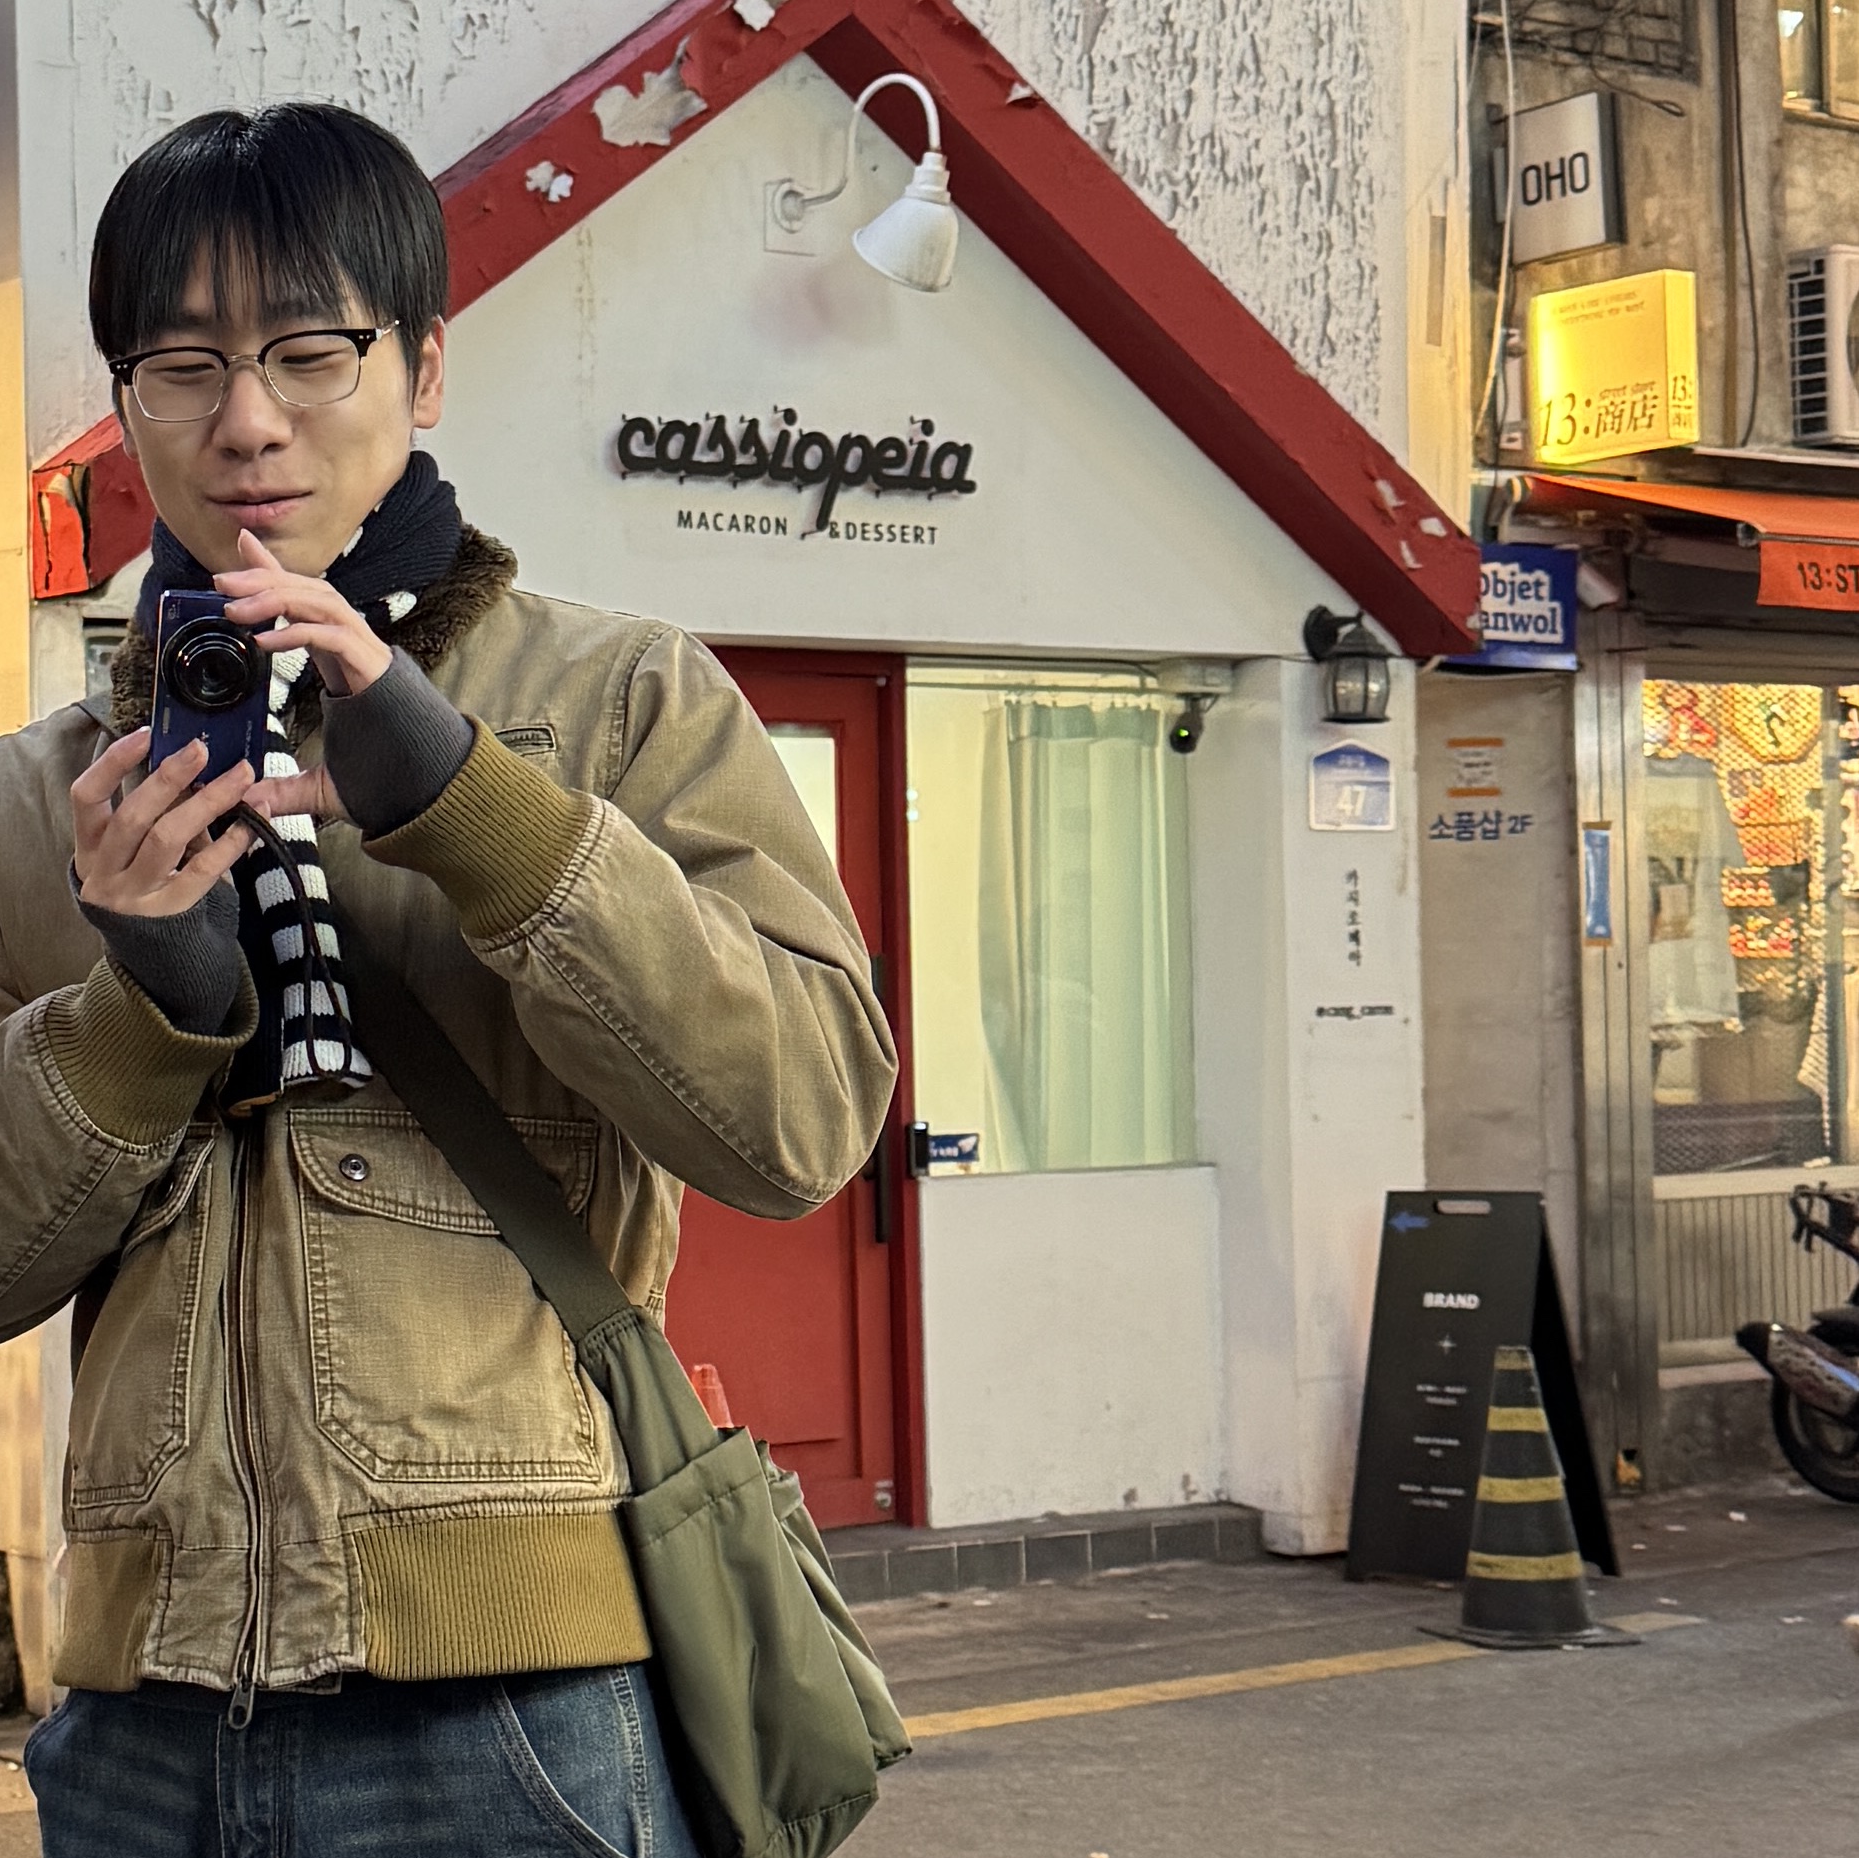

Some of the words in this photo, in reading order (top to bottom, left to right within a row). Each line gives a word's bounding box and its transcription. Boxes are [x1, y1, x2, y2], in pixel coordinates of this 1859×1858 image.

[1520, 150, 1590, 208] OHO
[616, 405, 977, 532] cassiopeia
[677, 510, 789, 536] MACARON
[1482, 606, 1559, 635] anwol
[1422, 1292, 1480, 1309] BRAND
